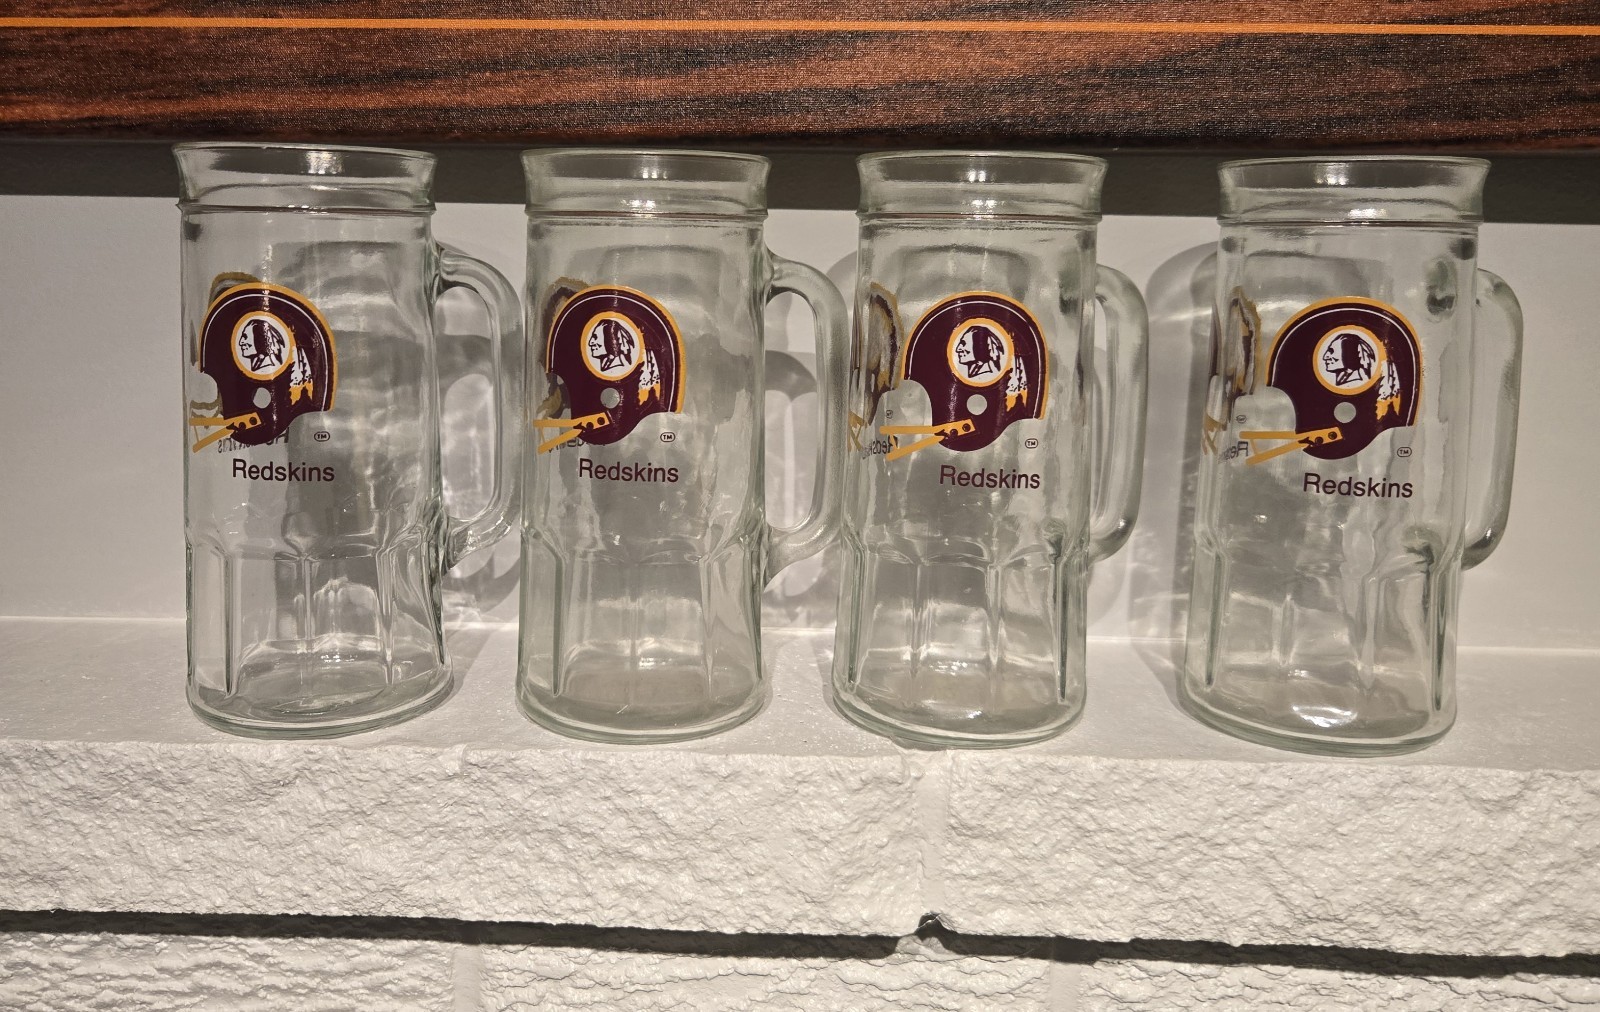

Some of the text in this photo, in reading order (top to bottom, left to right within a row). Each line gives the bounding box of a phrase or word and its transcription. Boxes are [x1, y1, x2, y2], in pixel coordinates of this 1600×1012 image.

[232, 458, 335, 482] Redskins
[579, 458, 679, 482] Redskins
[939, 464, 1041, 489] Redskins
[1303, 472, 1413, 498] Redskins
